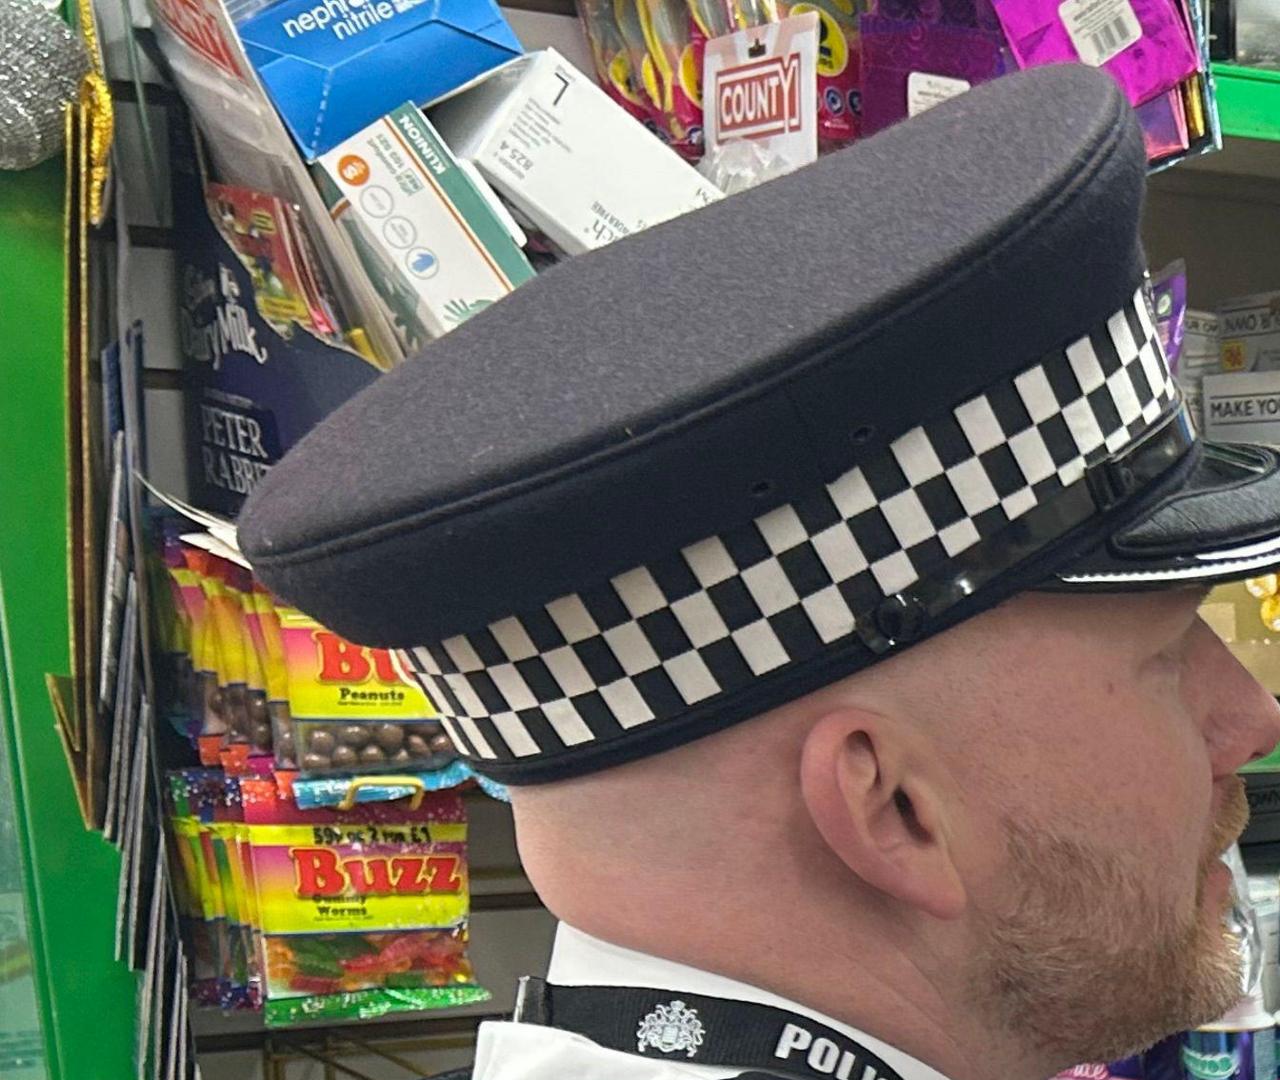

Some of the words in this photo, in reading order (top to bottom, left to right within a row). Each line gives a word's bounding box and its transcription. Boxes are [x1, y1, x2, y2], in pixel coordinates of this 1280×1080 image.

[333, 2, 394, 40] nitrile
[719, 54, 800, 128] COUNTY
[399, 113, 447, 176] KLINION
[1210, 401, 1248, 418] MAKE
[341, 688, 404, 701] Peanuts
[291, 847, 462, 898] Buzz
[316, 906, 368, 917] Worms
